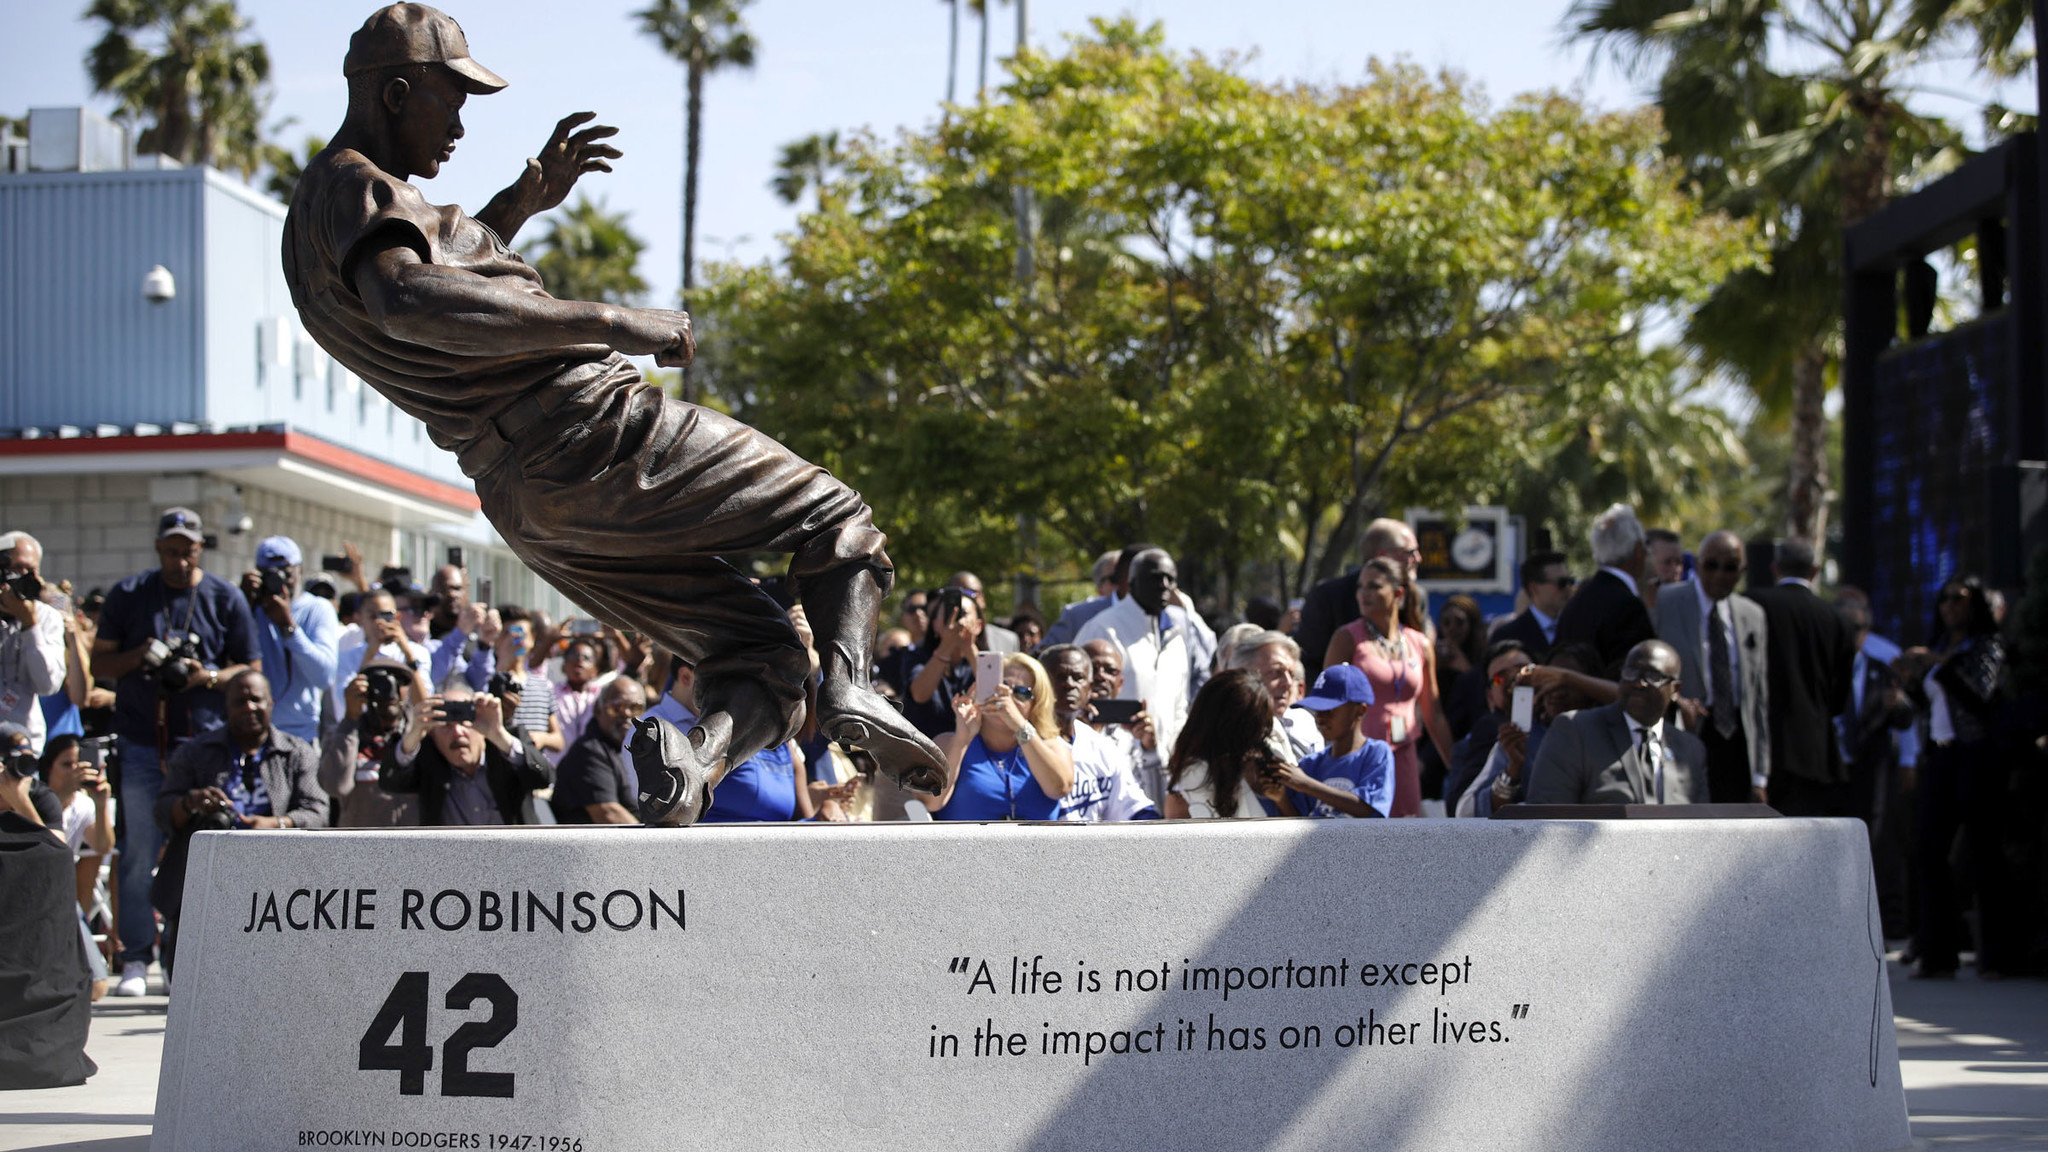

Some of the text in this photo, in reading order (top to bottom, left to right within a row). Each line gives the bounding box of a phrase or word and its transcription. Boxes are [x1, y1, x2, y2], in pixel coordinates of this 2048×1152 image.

[243, 888, 686, 934] JACKIE ROBINSON
[1011, 955, 1062, 995] life
[1077, 960, 1101, 993] is
[1115, 961, 1171, 992] not
[1182, 958, 1350, 1002] important
[1360, 955, 1472, 996] except
[358, 971, 519, 1099] 42
[930, 1025, 959, 1058] in
[974, 1018, 1027, 1057] the
[1042, 1022, 1166, 1066] impact
[1177, 1019, 1196, 1052] it
[1207, 1013, 1267, 1051] has
[1279, 1026, 1321, 1050] on
[1334, 1008, 1421, 1048] other
[299, 1130, 583, 1152] BROOKLYN DODGERS 1947-1956
